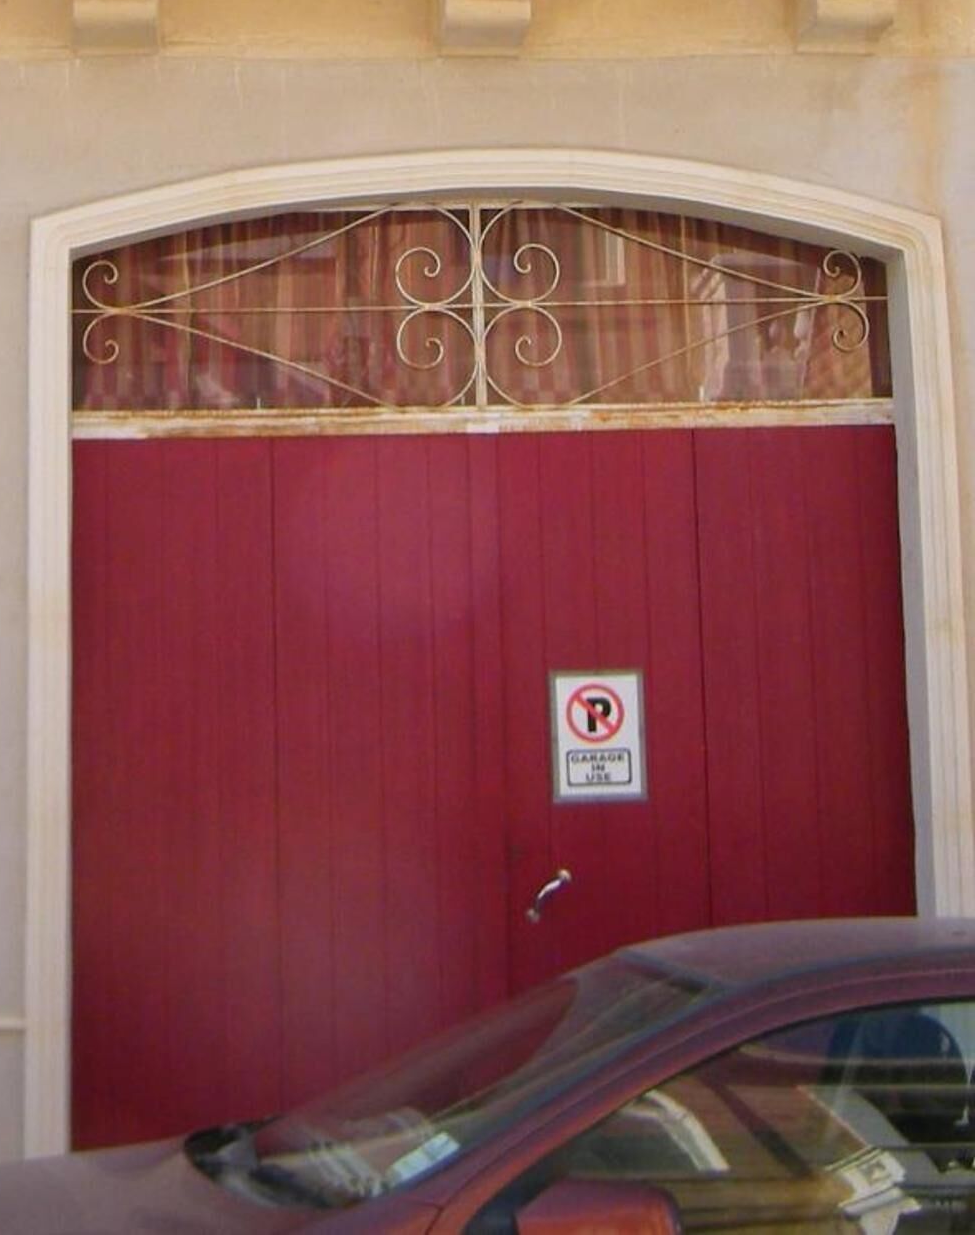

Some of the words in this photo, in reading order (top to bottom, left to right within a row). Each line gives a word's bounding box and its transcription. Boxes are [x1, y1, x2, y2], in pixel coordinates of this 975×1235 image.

[571, 754, 625, 763] GARAGE
[591, 764, 605, 772] IN
[586, 773, 611, 782] USE
